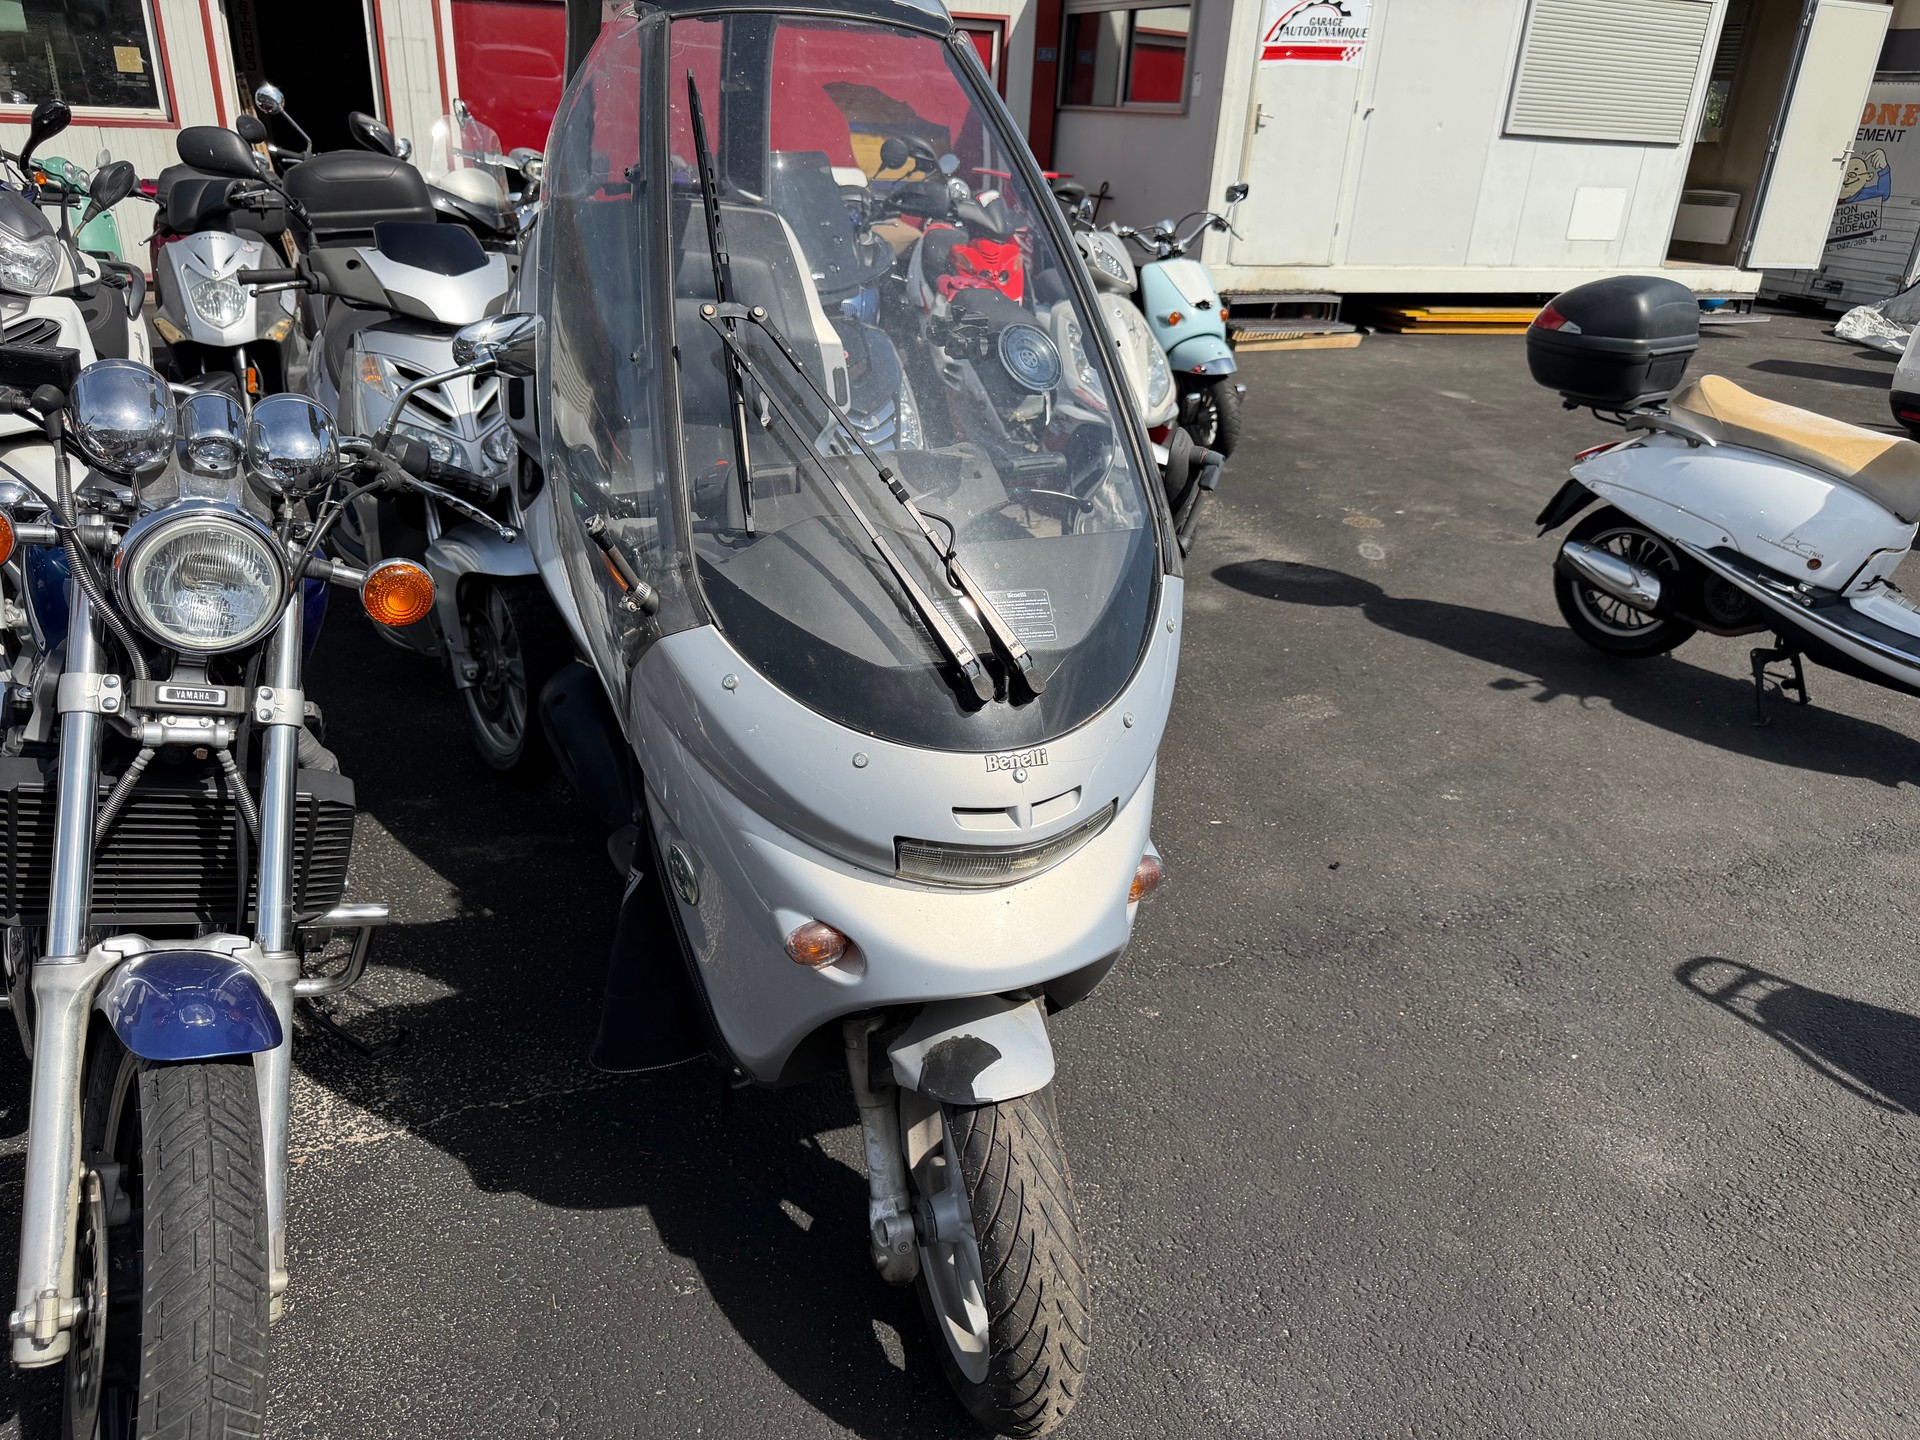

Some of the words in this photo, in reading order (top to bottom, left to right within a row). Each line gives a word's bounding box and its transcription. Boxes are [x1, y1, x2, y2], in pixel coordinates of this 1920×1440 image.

[1309, 17, 1344, 27] GARAGE
[1282, 26, 1369, 39] AUTODYNAMIQUE
[1855, 128, 1906, 143] EMENT
[1833, 204, 1858, 218] TION
[1840, 209, 1878, 225] DESIGN
[1835, 218, 1878, 235] RIDEAUX
[175, 690, 210, 700] YAMAHA
[984, 748, 1049, 772] Benelli
